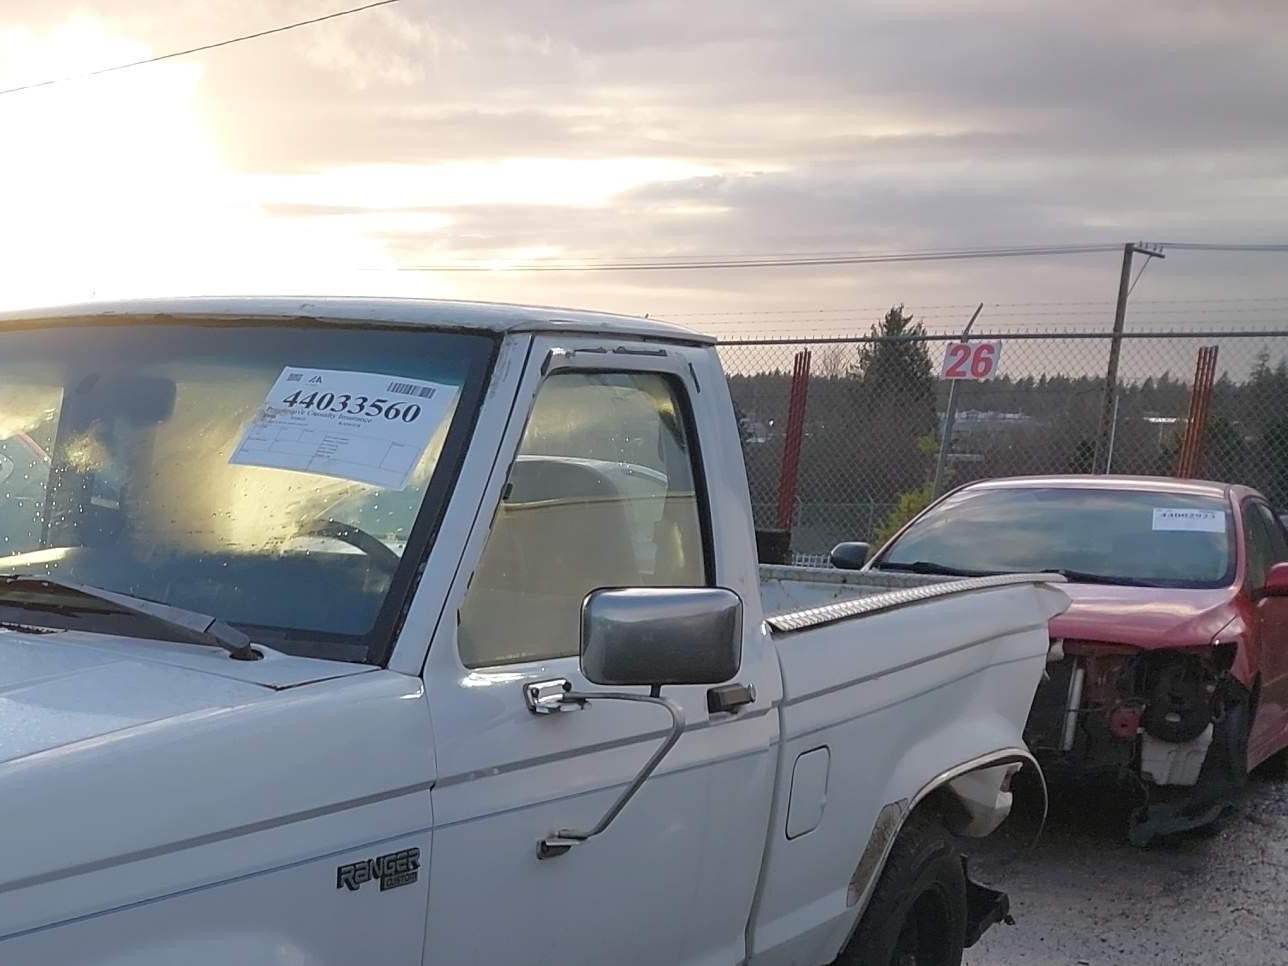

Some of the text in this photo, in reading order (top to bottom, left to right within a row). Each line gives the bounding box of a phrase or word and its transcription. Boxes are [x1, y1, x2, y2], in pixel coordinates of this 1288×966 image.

[945, 344, 994, 378] 26
[283, 390, 421, 423] 44033560
[336, 848, 420, 891] RANGER
